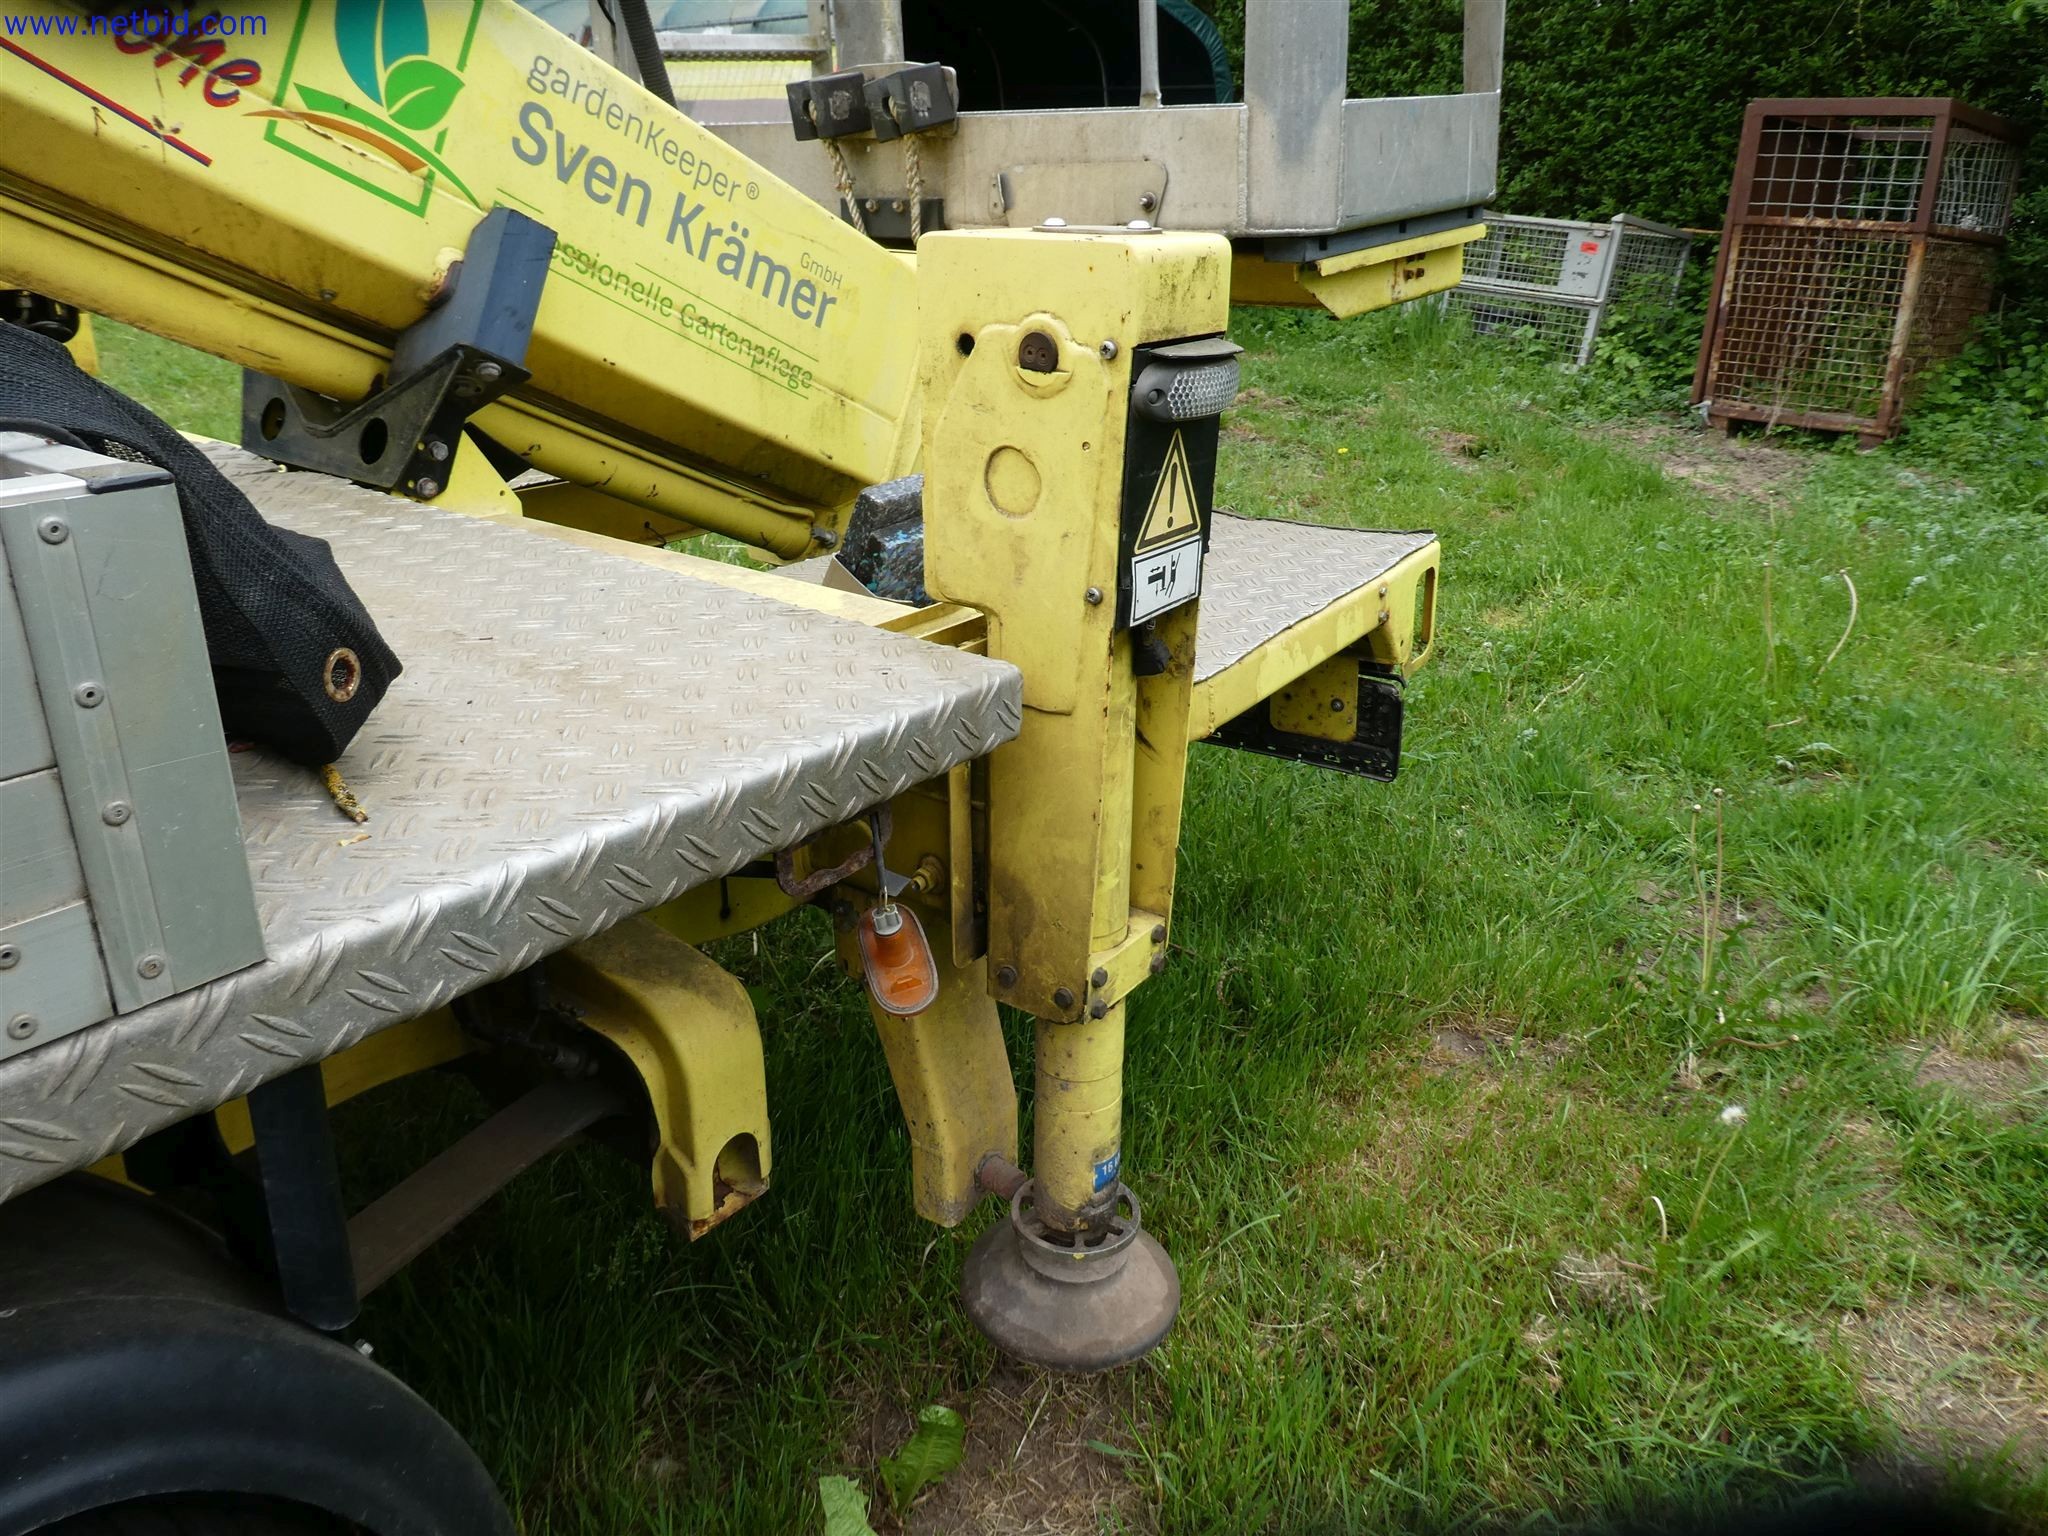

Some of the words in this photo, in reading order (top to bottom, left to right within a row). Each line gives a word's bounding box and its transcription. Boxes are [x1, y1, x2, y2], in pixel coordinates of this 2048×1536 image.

[511, 101, 652, 227] Sven
[666, 191, 838, 330] Krämer
[800, 251, 843, 289] GmbH
[680, 303, 813, 390] Gartenpflege
